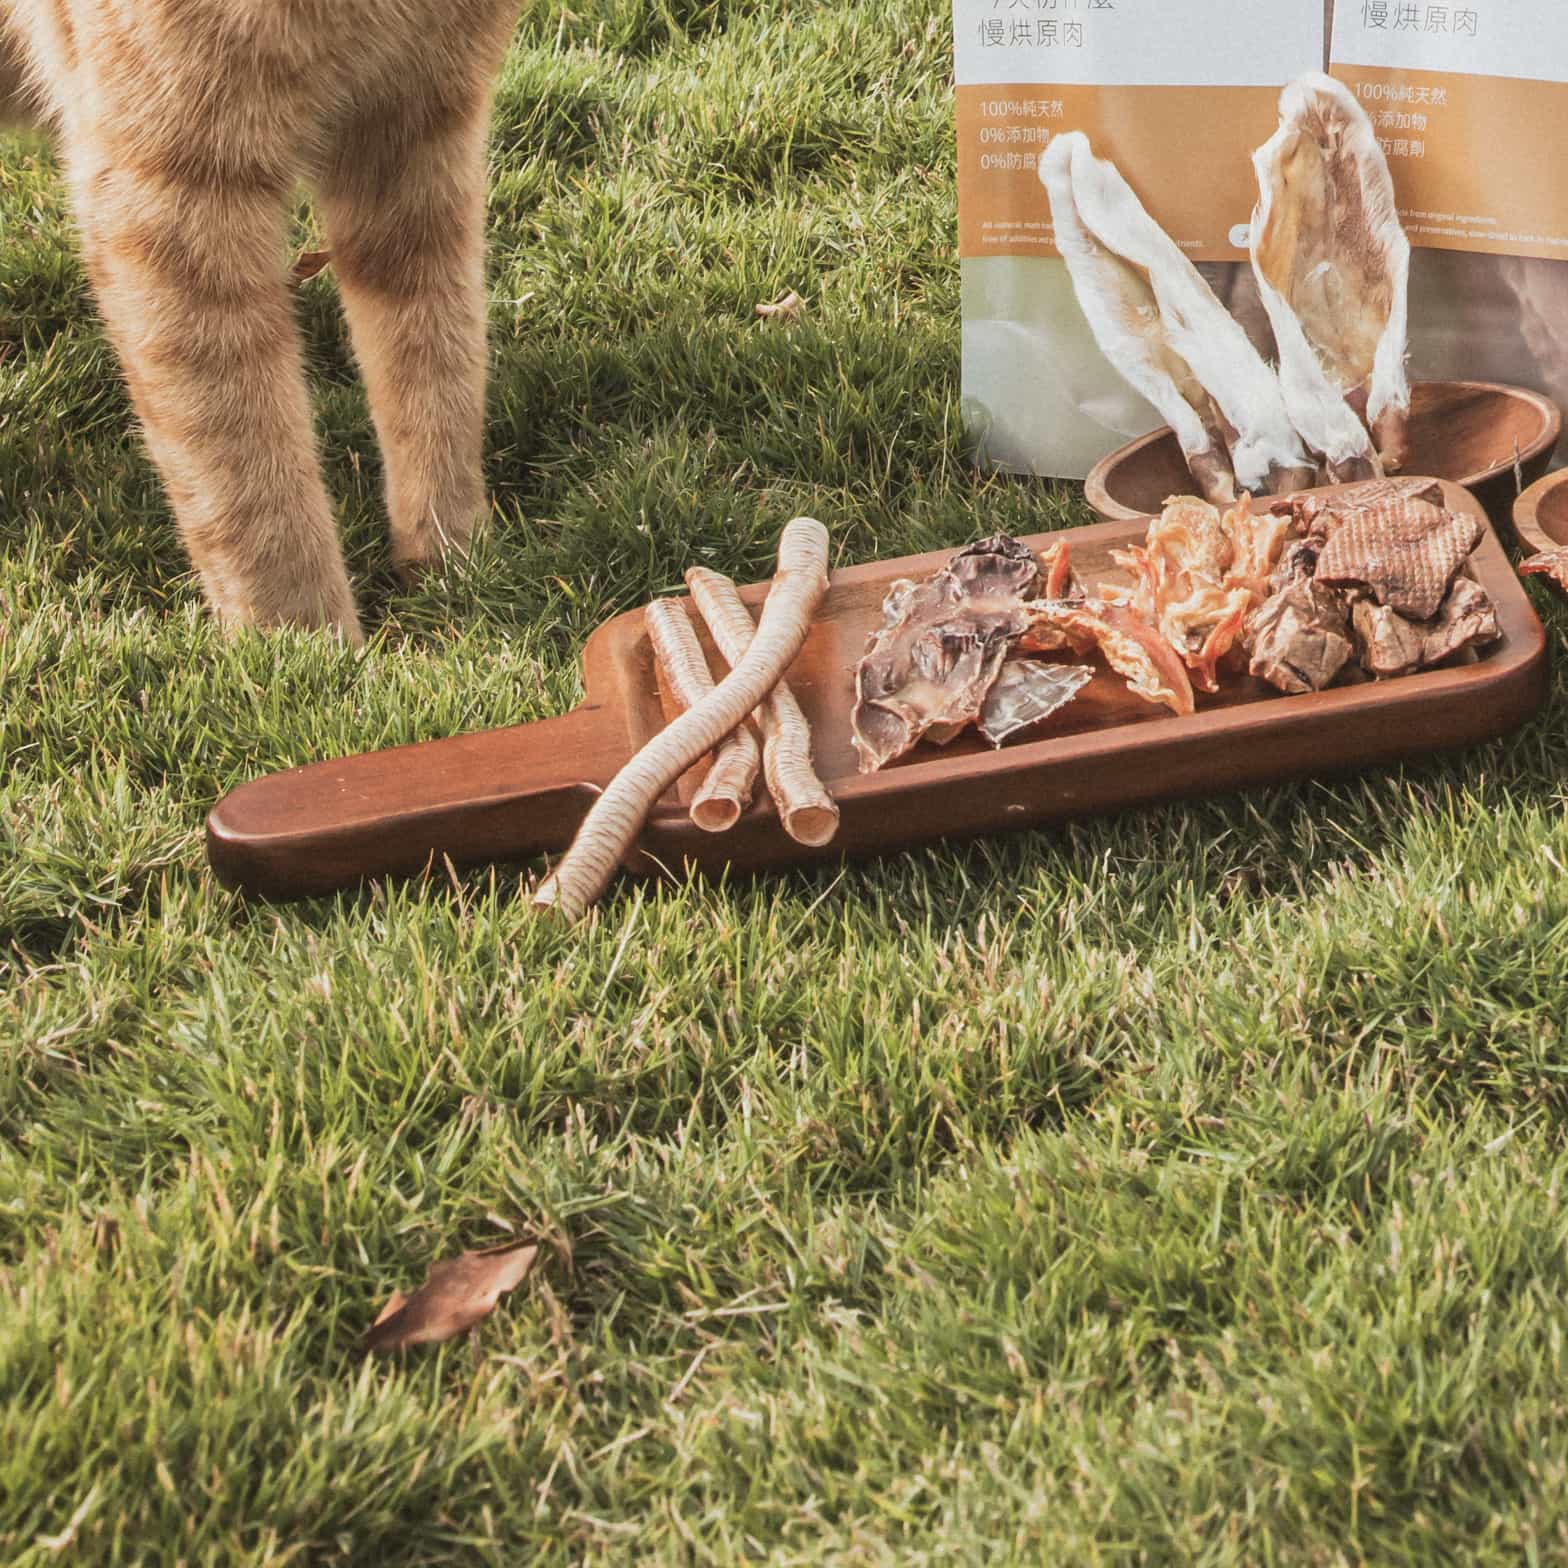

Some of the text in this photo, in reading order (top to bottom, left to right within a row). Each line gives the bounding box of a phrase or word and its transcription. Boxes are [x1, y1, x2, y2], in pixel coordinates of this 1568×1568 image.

[1361, 0, 1479, 37] 慢烘原肉
[978, 19, 1084, 48] 慢烘原肉
[980, 152, 1038, 171] 0%防腐
